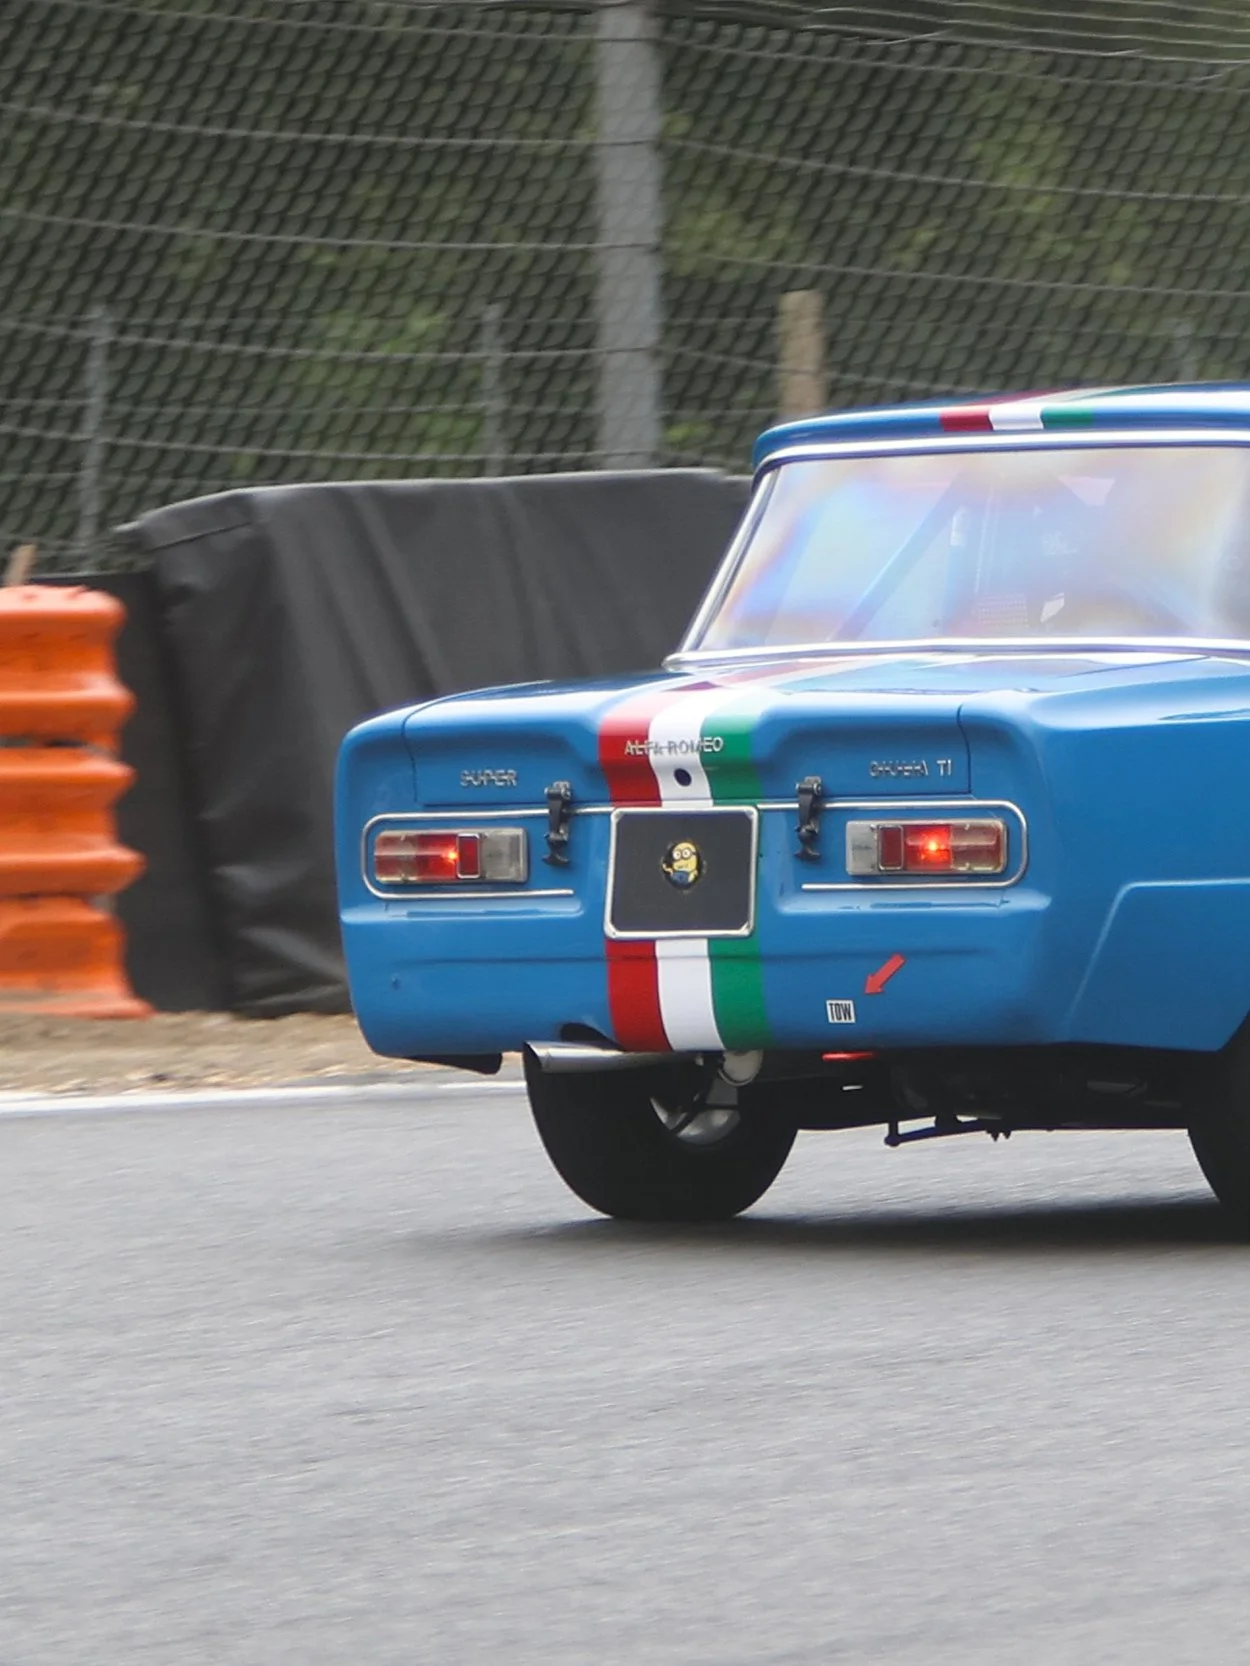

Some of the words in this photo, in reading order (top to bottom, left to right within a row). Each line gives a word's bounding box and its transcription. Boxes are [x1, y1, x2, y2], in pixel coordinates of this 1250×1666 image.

[667, 736, 723, 756] ROMEO
[936, 759, 952, 776] TI
[460, 769, 517, 787] SUPER
[829, 1002, 852, 1021] TOW
